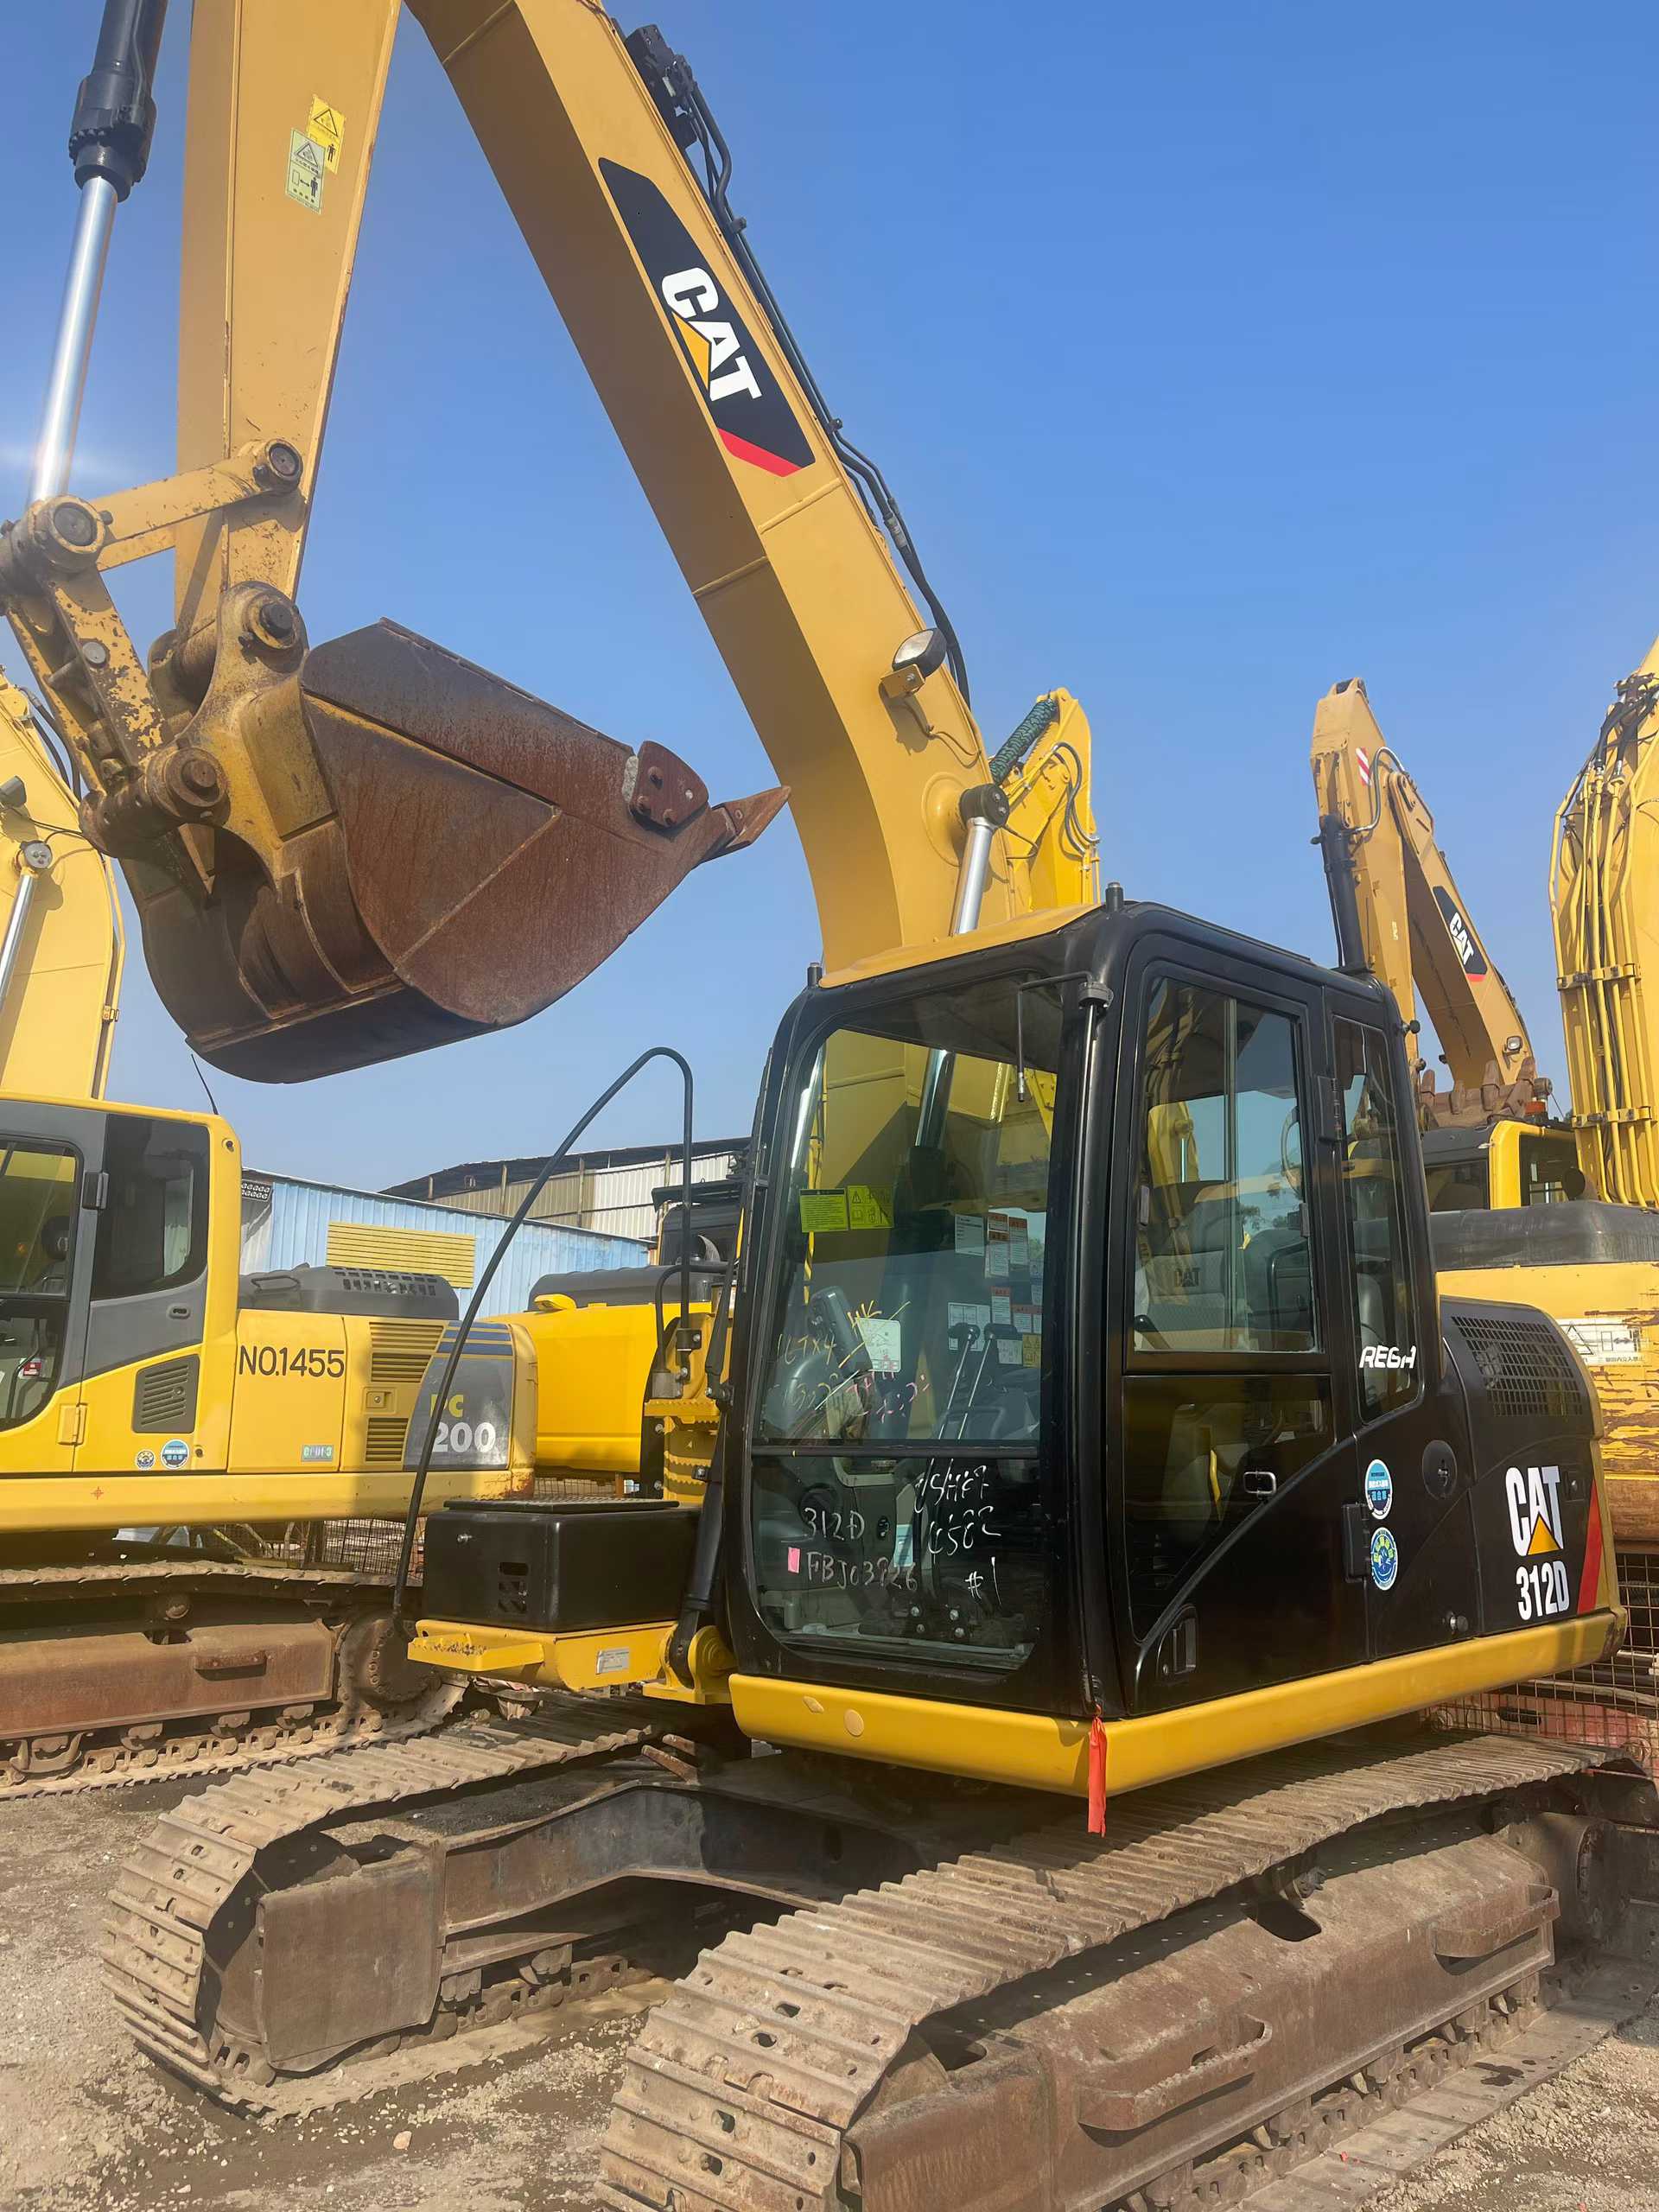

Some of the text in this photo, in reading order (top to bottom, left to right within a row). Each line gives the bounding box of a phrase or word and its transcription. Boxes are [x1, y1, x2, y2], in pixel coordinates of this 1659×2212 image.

[662, 267, 762, 402] CAT
[1449, 912, 1474, 966] CAT
[238, 1345, 345, 1378] NO.1455
[432, 1421, 496, 1452] 200
[804, 1507, 865, 1541] 312D
[1505, 1465, 1564, 1557] CAT
[1516, 1560, 1570, 1621] 312D
